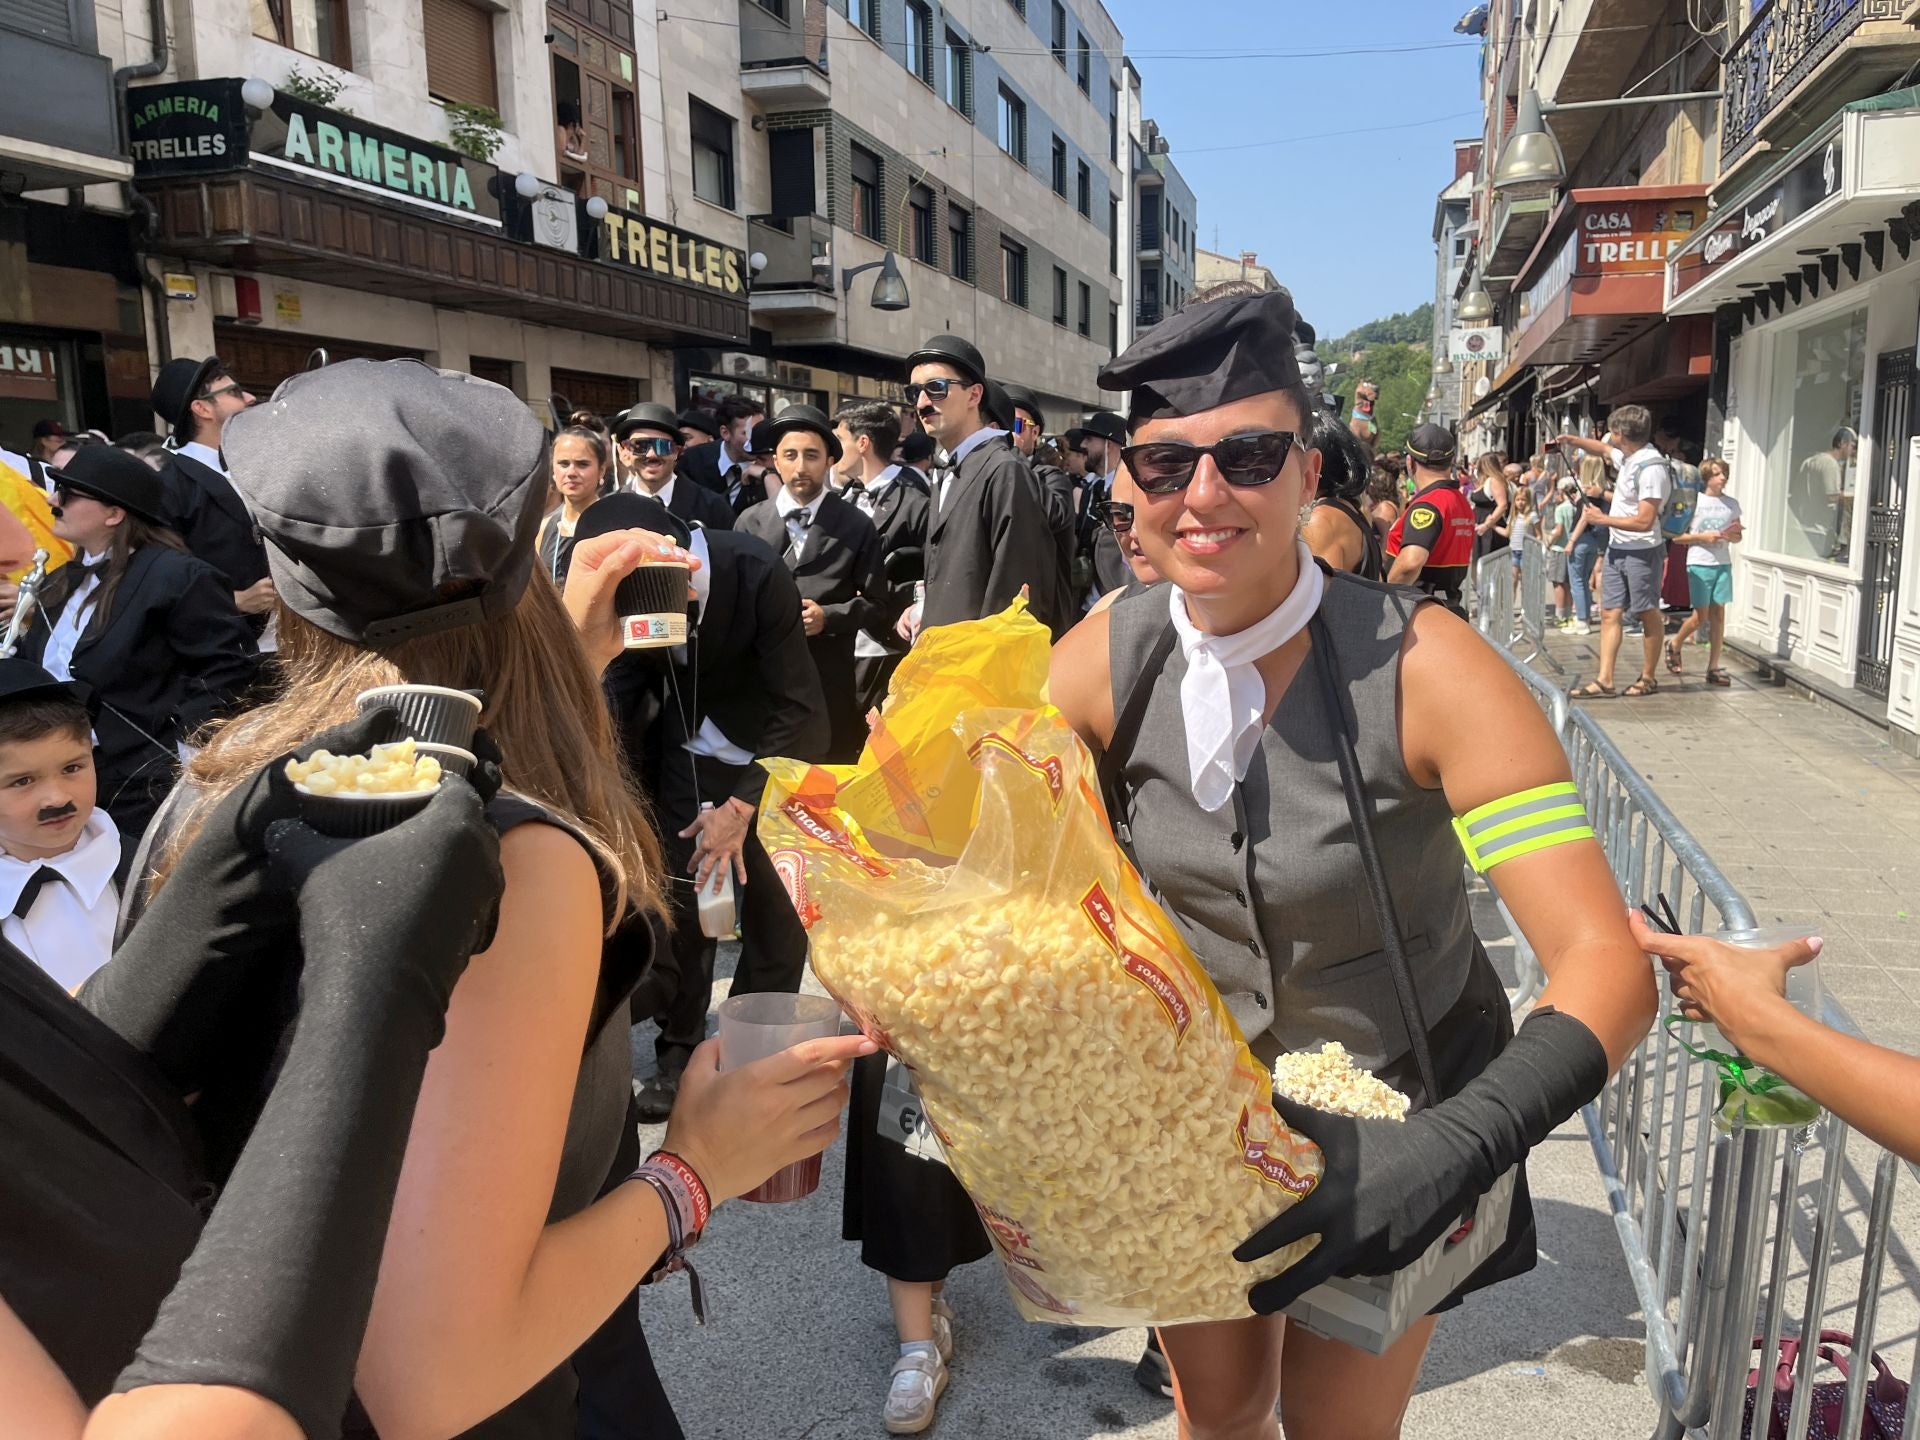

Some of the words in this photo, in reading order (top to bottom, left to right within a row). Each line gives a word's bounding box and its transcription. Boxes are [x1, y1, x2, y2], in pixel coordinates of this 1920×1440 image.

[133, 95, 219, 129] ARMERIA
[131, 133, 227, 161] TRELLES
[284, 112, 476, 211] ARMERIA
[1584, 212, 1632, 230] CASA
[603, 211, 739, 294] TRELLES
[1583, 239, 1683, 264] TRELLE
[1453, 351, 1499, 361] BUNKAI
[1136, 964, 1187, 1024] Aperitivos
